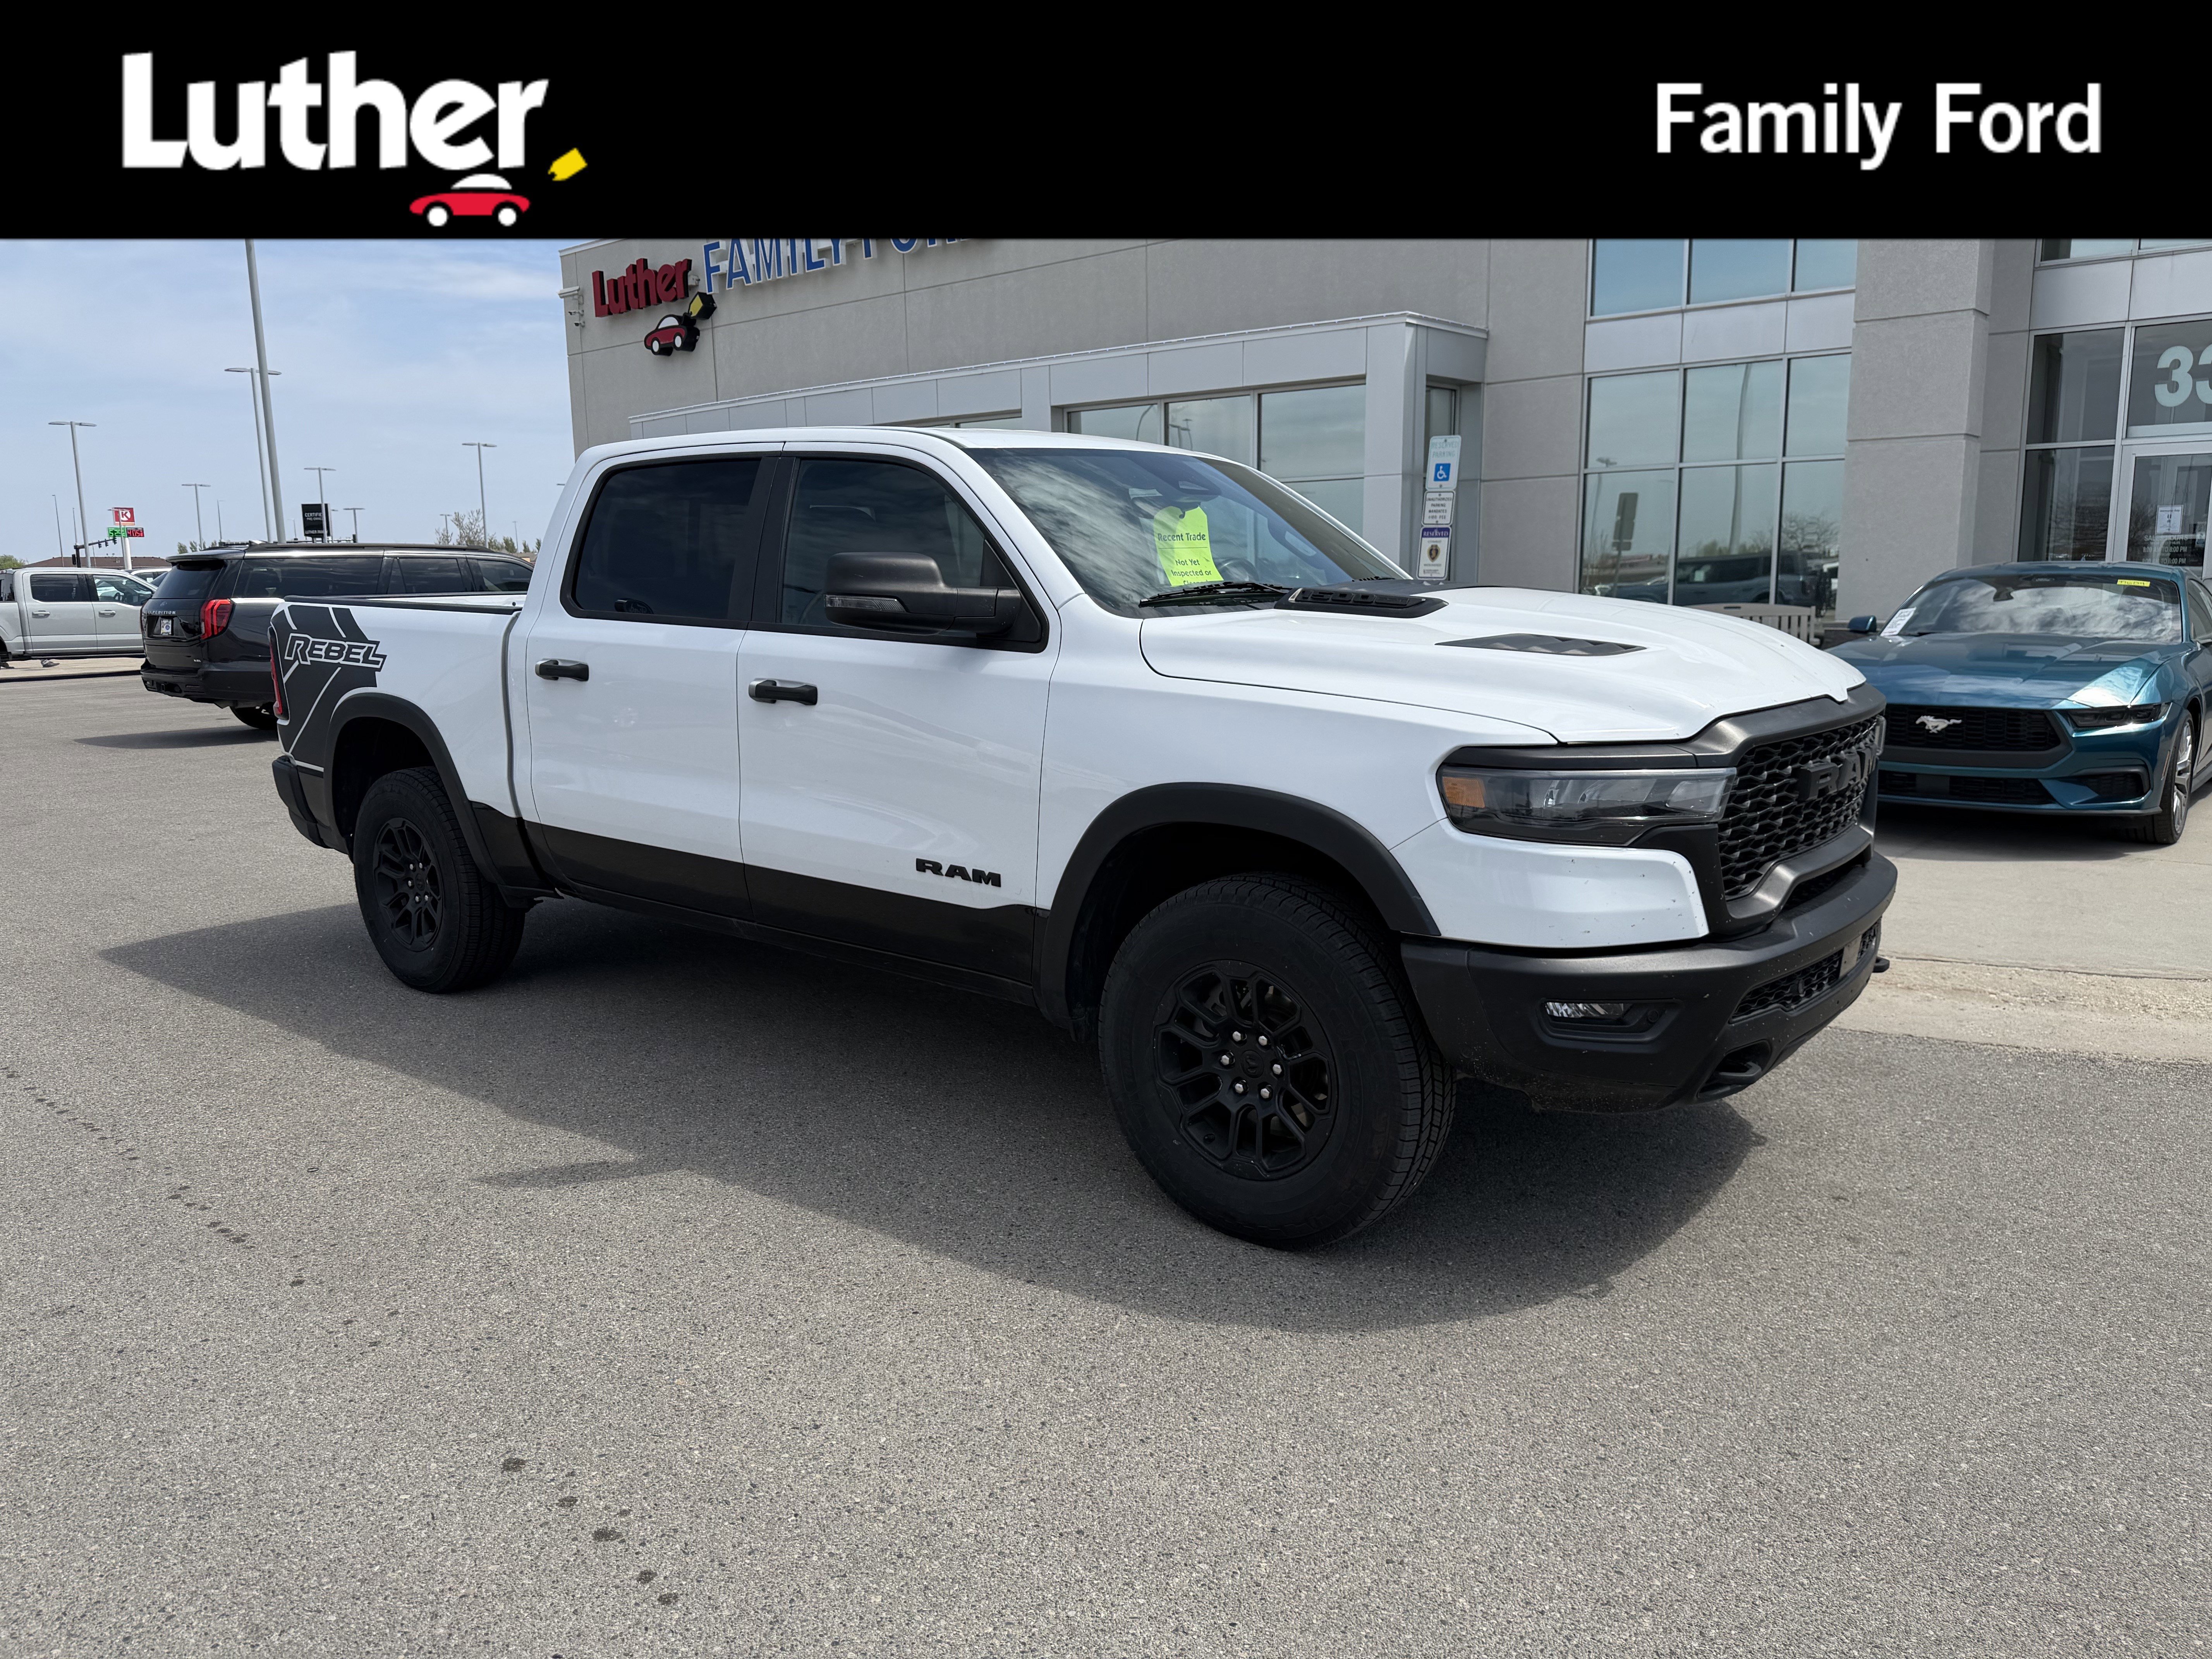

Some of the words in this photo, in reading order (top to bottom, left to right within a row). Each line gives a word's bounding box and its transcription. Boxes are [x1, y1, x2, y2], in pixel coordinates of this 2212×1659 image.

[592, 258, 692, 317] Luther
[1158, 533, 1184, 541] Recent
[1185, 532, 1206, 541] Trade
[1171, 569, 1204, 577] Inspected
[1301, 589, 1375, 603] 1500
[285, 633, 385, 669] REBEL
[1800, 748, 1877, 800] RAM
[916, 858, 1001, 888] RAM
